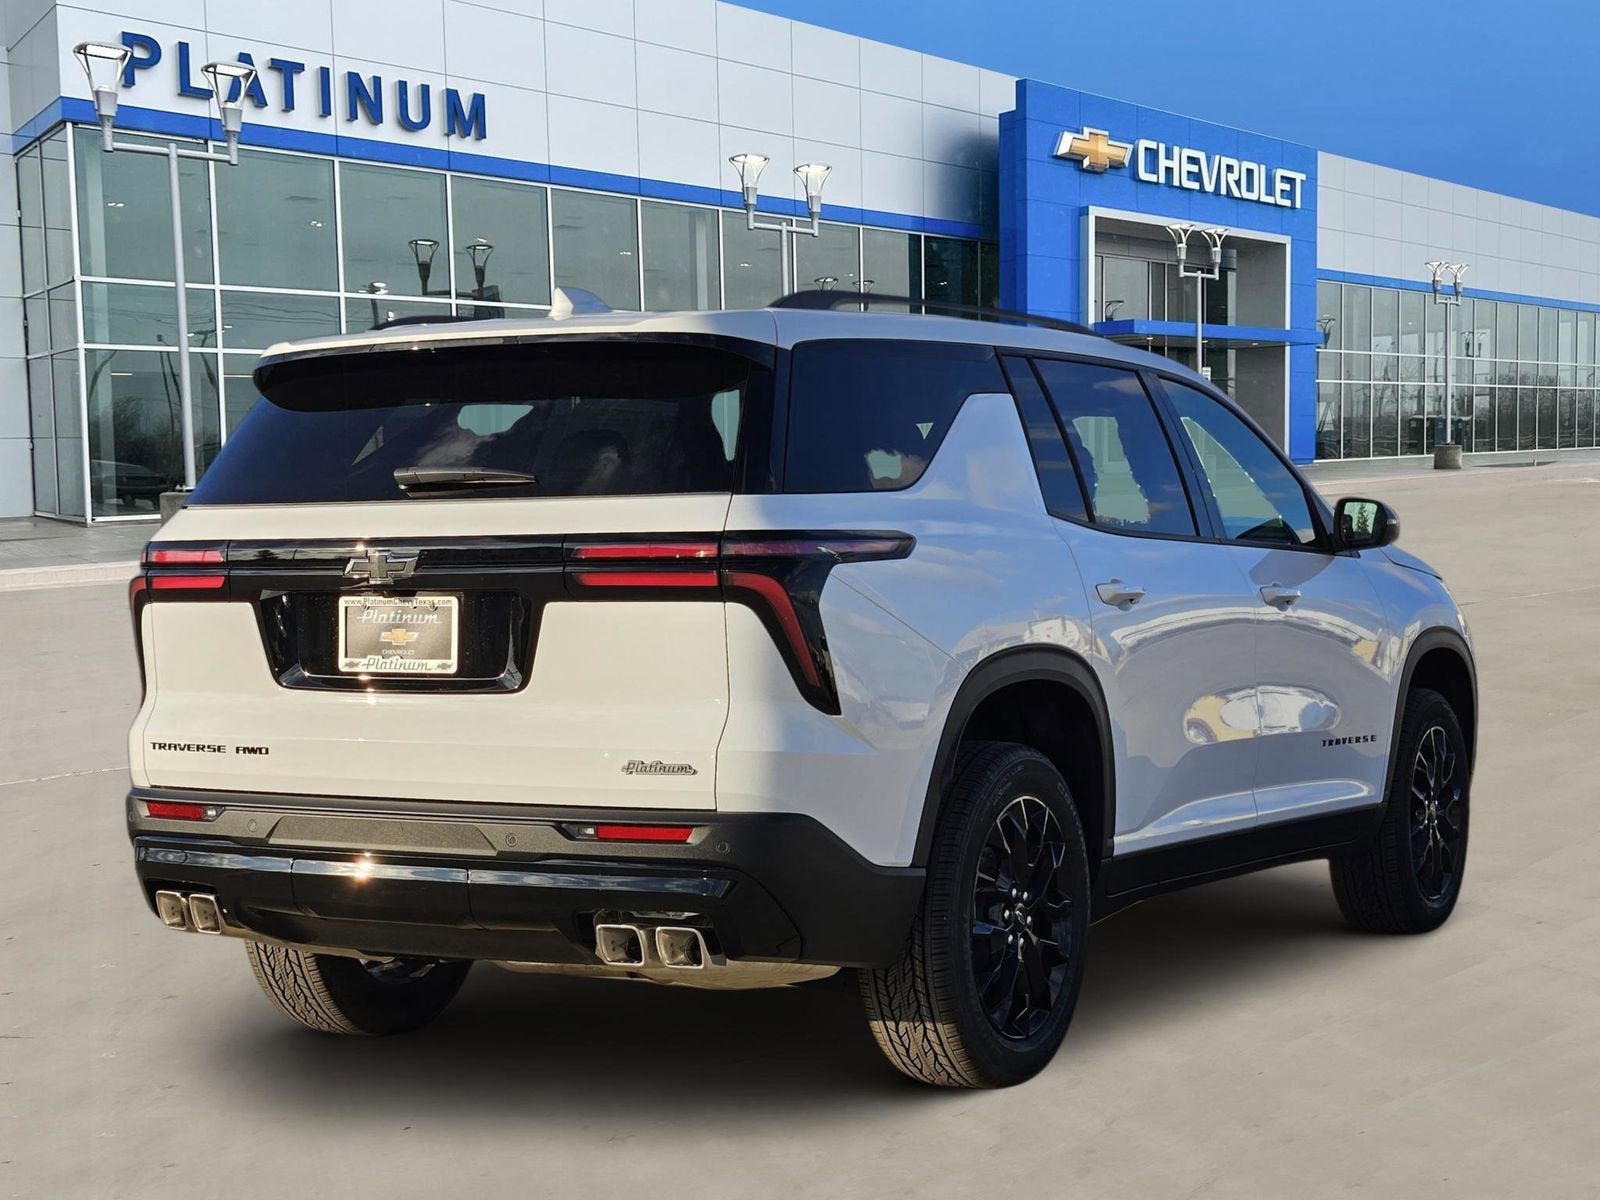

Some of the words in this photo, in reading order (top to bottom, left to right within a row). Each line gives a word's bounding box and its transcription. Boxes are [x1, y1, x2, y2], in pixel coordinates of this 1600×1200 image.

[121, 31, 488, 140] PLATINUM
[1136, 138, 1306, 209] CHEVROLET
[356, 610, 442, 623] Platinum
[362, 656, 434, 671] Platinum
[150, 742, 227, 753] TRAVERSE
[235, 746, 269, 755] AWD
[1322, 735, 1376, 747] TRAVERSE
[621, 759, 698, 775] Platinum
